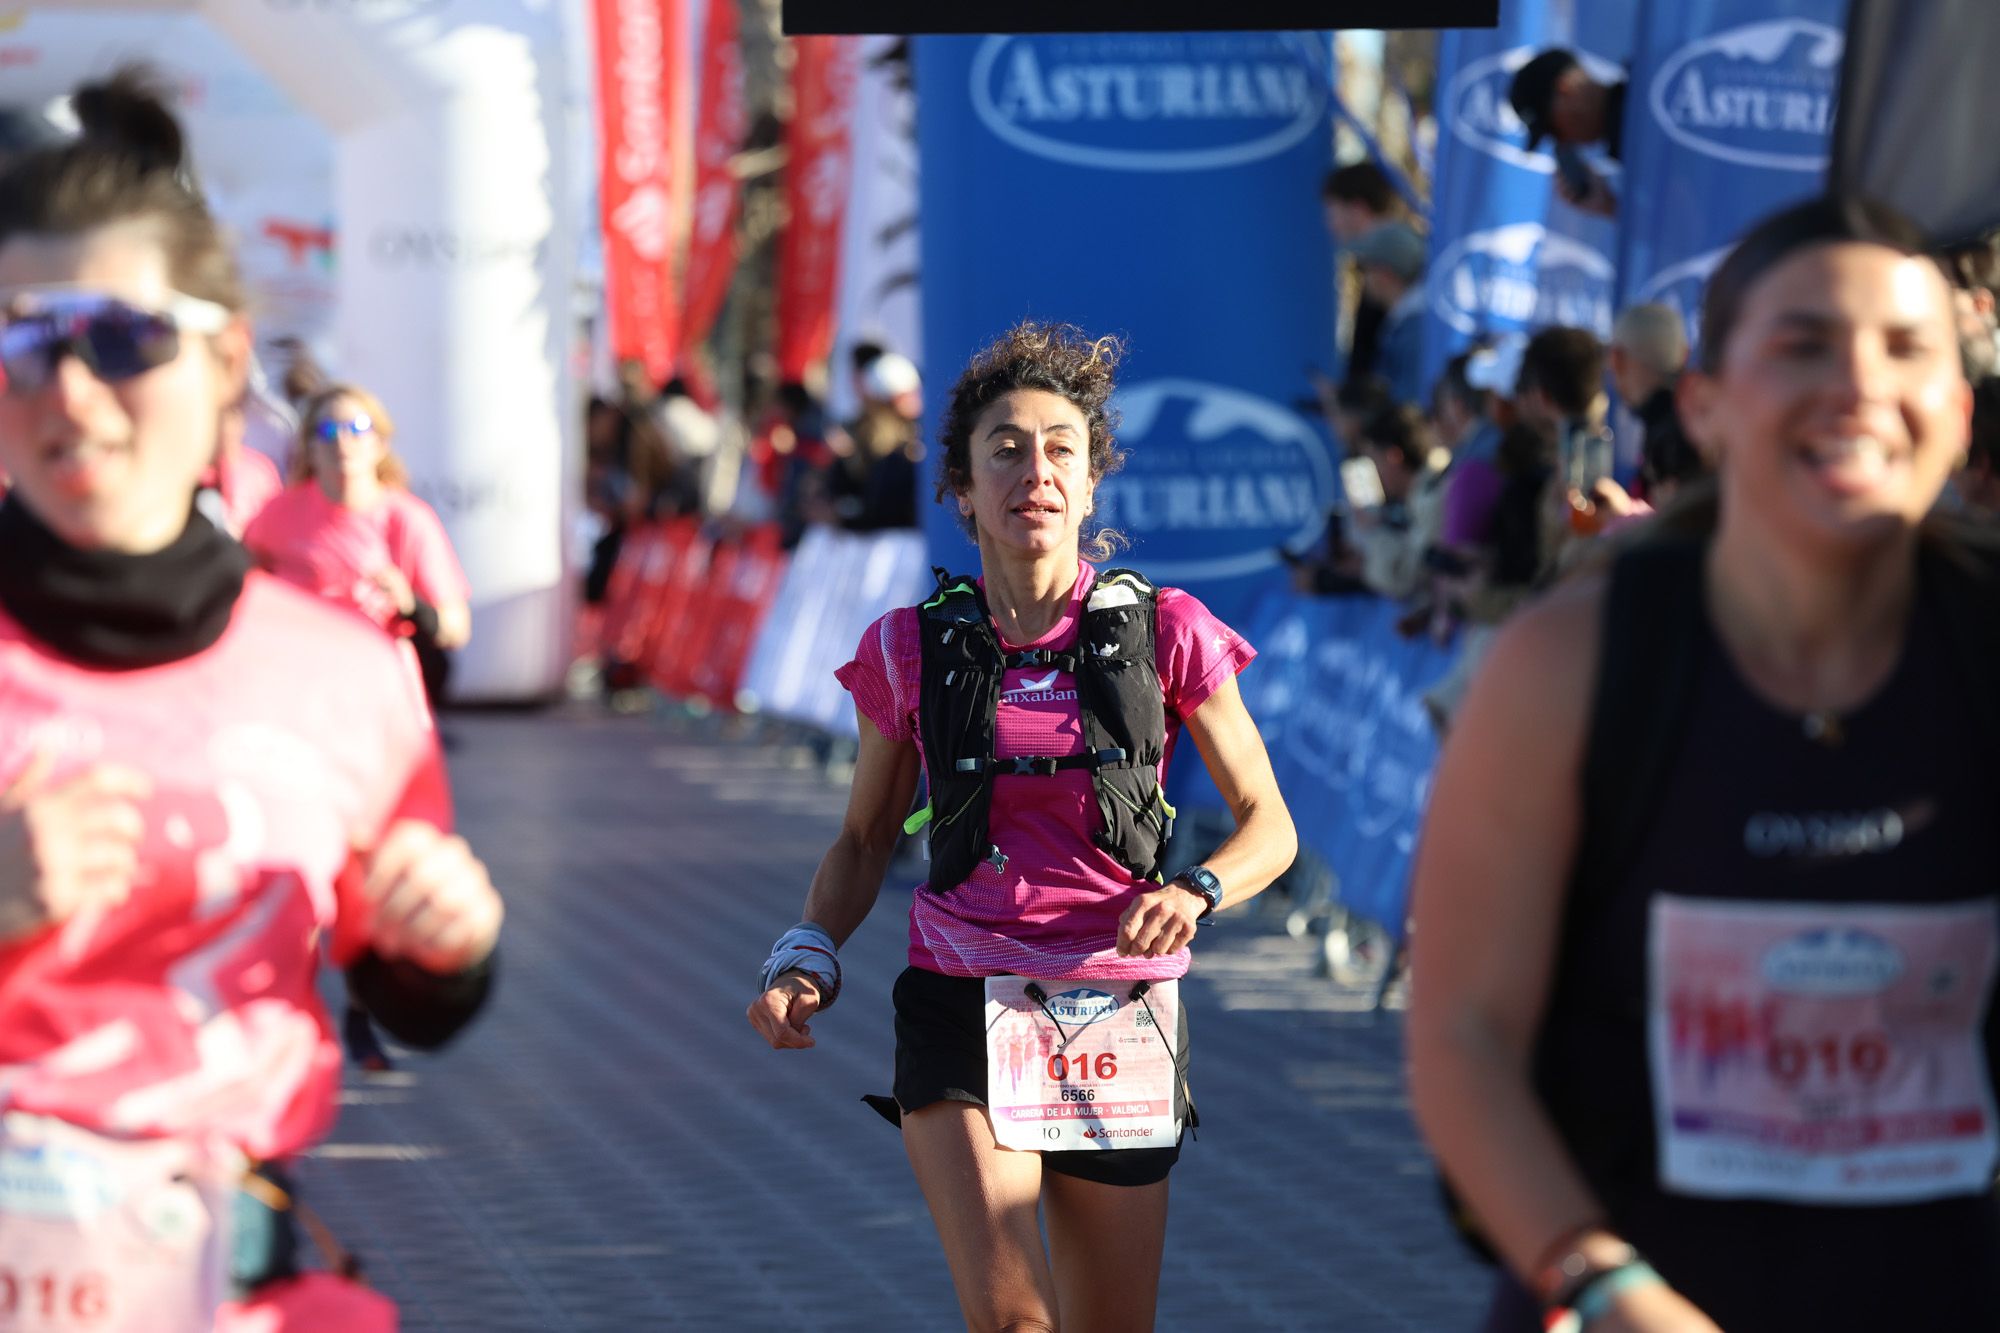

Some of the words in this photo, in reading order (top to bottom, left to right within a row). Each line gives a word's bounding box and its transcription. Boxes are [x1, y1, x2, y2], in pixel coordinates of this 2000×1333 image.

[1001, 40, 1312, 121] ASTURIAN
[1002, 688, 1078, 703] aixaBan
[1049, 1000, 1114, 1017] ASTURIANA
[1047, 1052, 1118, 1081] 016
[1061, 1089, 1095, 1102] 6566
[1010, 1109, 1045, 1119] CARRERA
[1047, 1108, 1058, 1117] DE
[1060, 1107, 1071, 1117] LA
[1074, 1106, 1104, 1116] MUJER
[1111, 1104, 1150, 1115] VALENCIA
[1098, 1127, 1153, 1138] Santander
